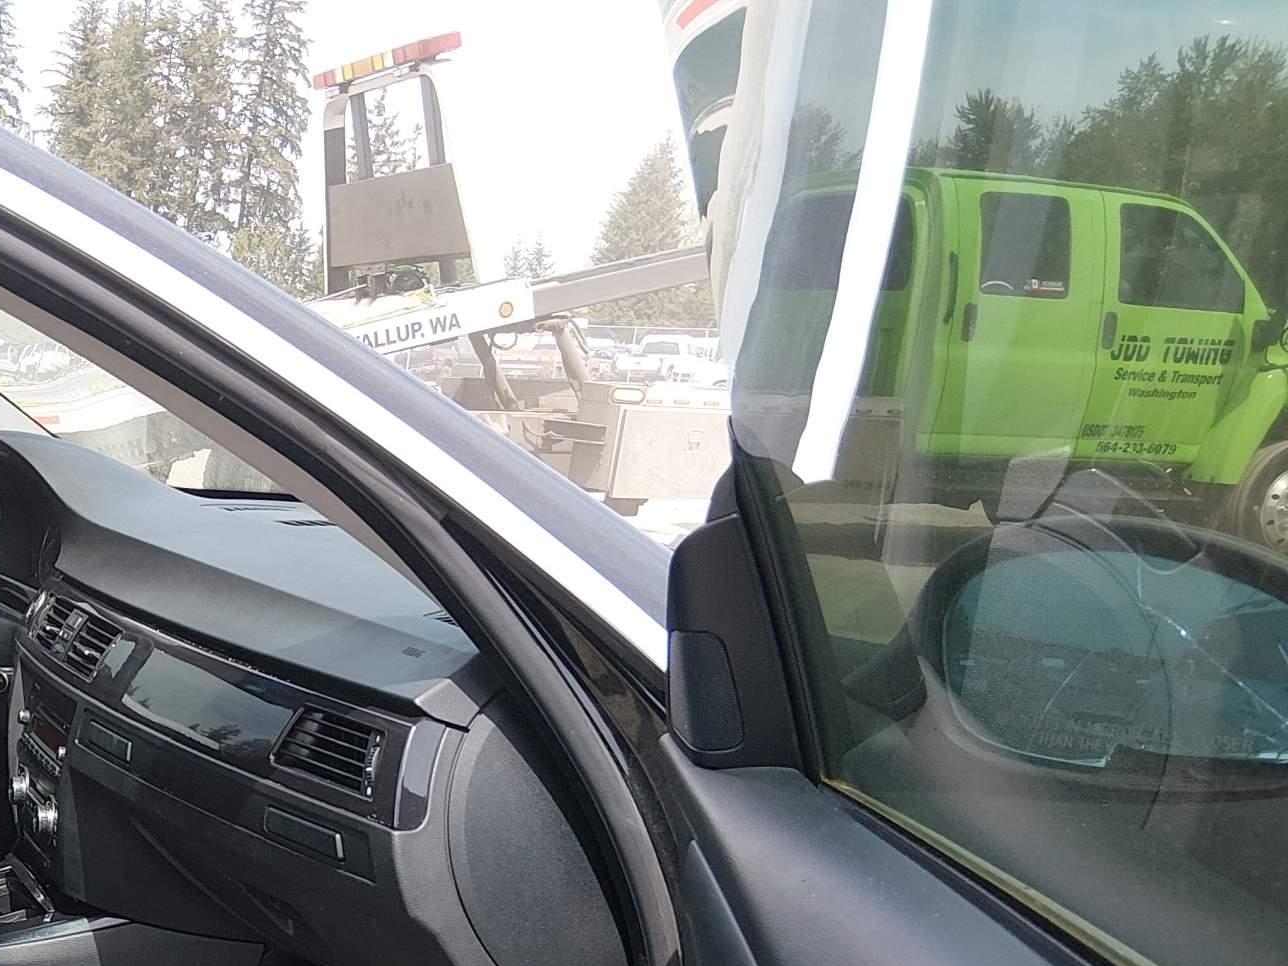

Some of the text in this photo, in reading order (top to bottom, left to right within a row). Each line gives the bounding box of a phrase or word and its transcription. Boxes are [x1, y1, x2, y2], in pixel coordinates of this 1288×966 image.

[356, 313, 461, 349] ALLUP, WA
[1161, 336, 1236, 365] TOWING
[1114, 366, 1224, 387] Service & Transport
[1128, 387, 1198, 401] Washington
